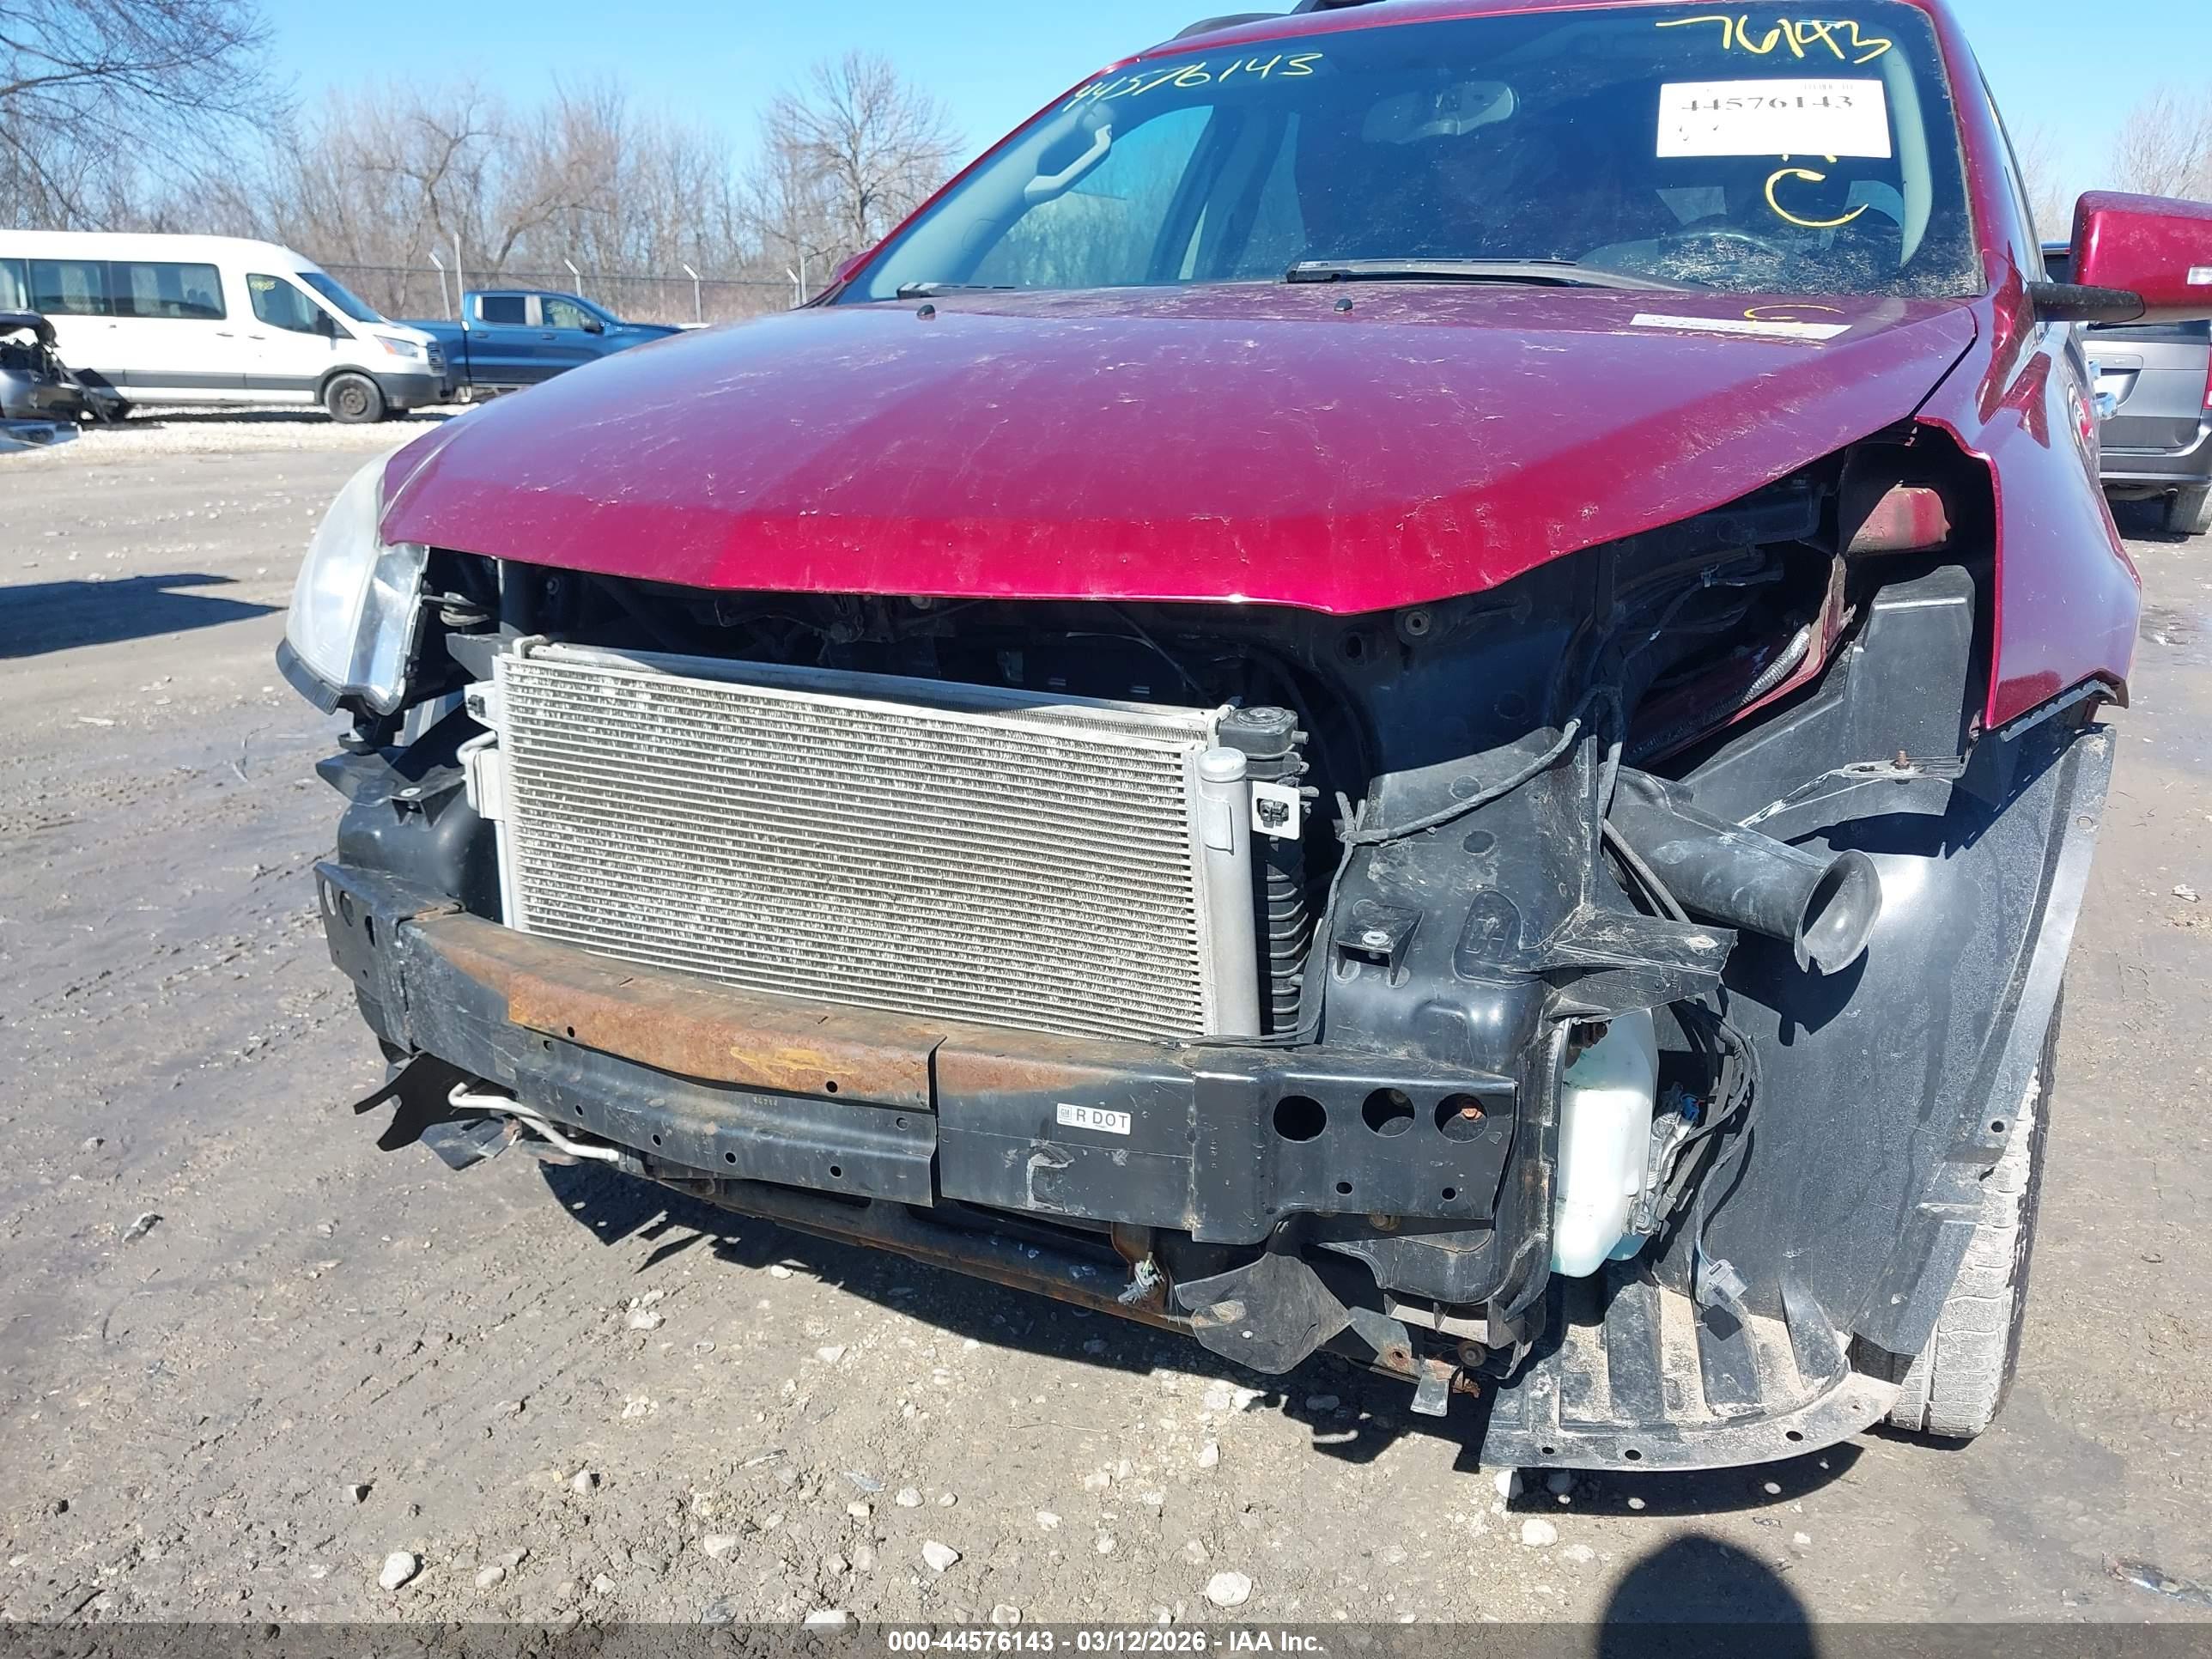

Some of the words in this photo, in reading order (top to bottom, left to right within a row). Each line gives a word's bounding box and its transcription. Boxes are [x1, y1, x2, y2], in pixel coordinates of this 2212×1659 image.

[1062, 53, 1324, 112] 44576143
[1076, 1109, 1086, 1122] R
[1092, 1111, 1128, 1128] DOT
